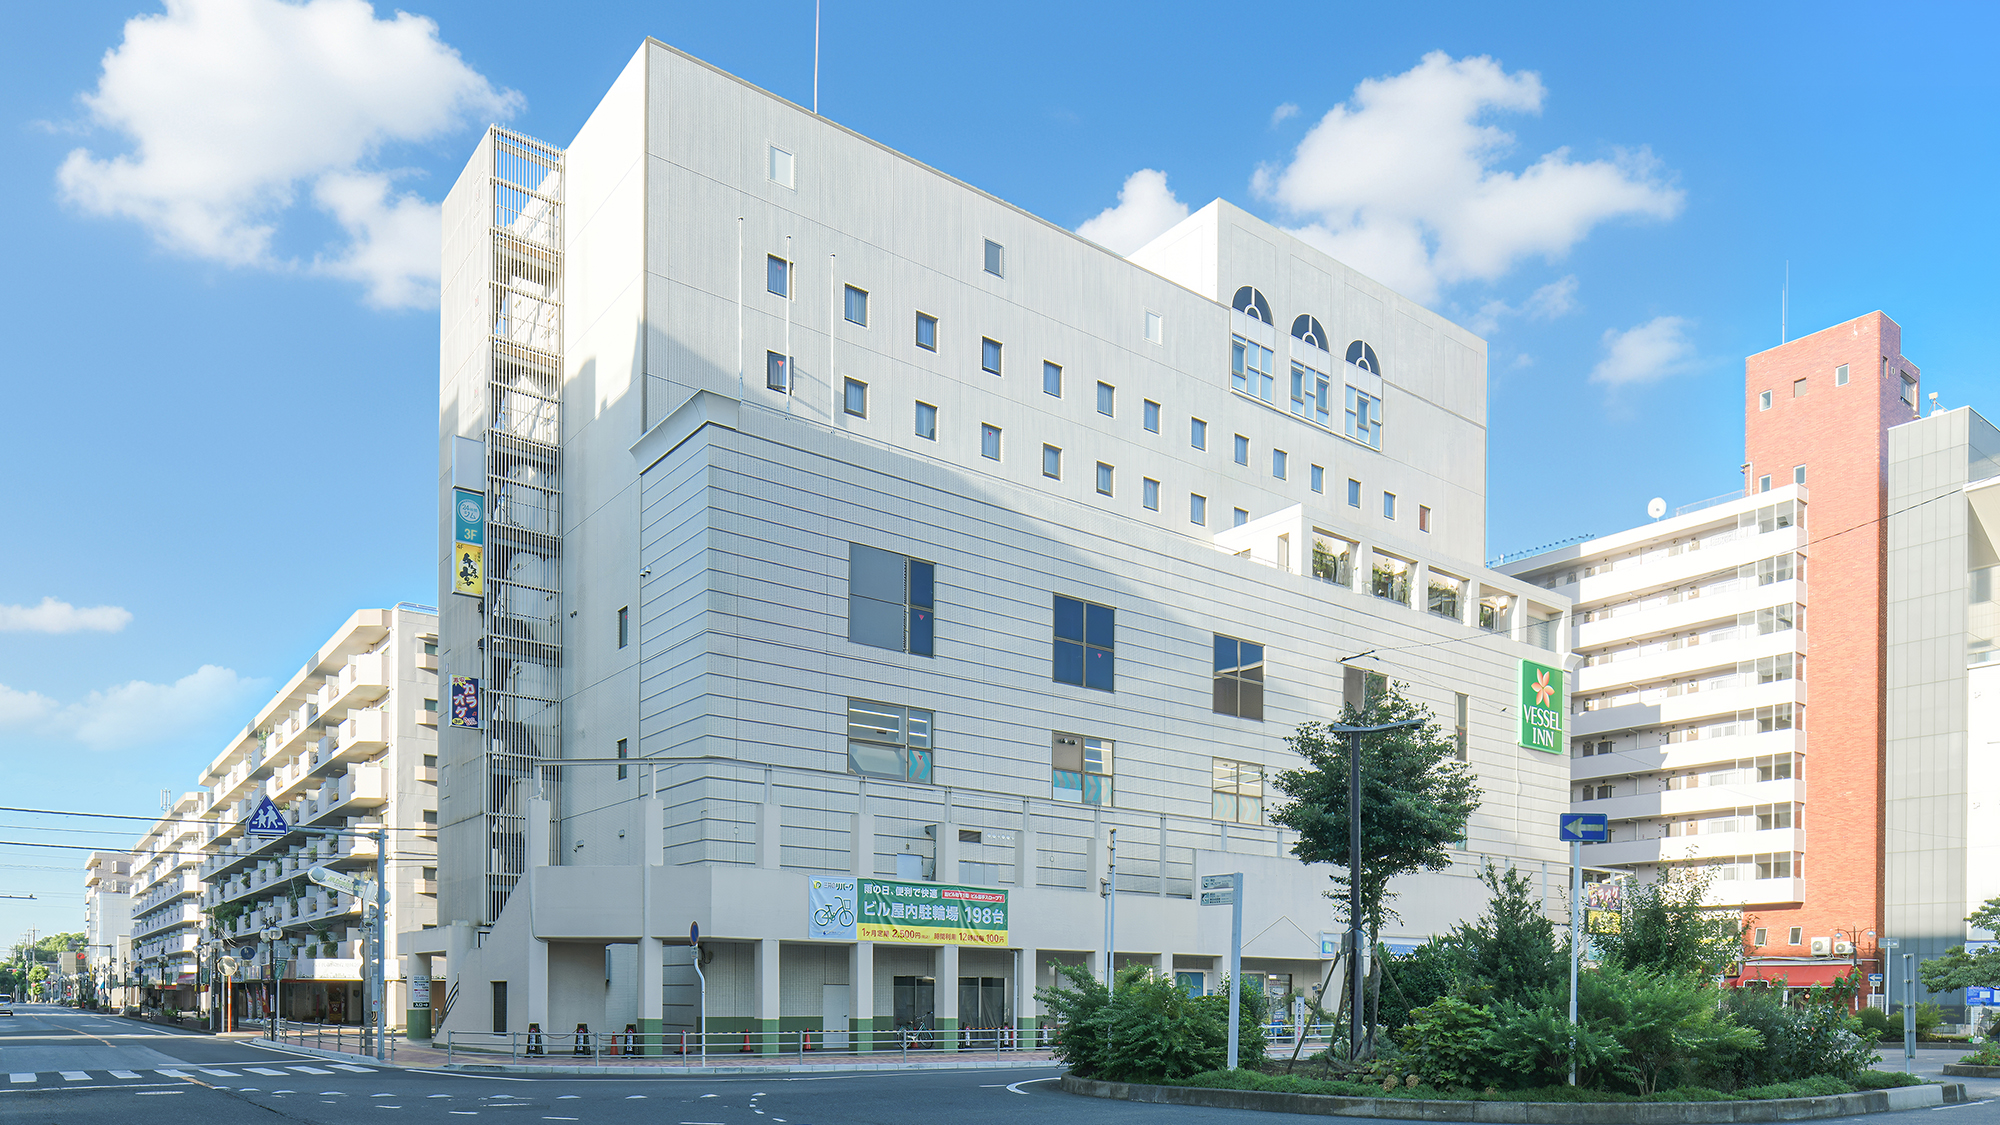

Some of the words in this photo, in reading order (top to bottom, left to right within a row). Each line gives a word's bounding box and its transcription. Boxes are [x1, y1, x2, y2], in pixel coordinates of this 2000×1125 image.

[463, 528, 478, 541] 3F
[1523, 704, 1562, 731] VESSEL
[1532, 727, 1554, 748] INN
[863, 883, 938, 899] 雨の日、便利で快適
[863, 900, 959, 922] ビル屋内駐輪場
[964, 906, 1004, 925] 198台
[986, 933, 1005, 943] 100円
